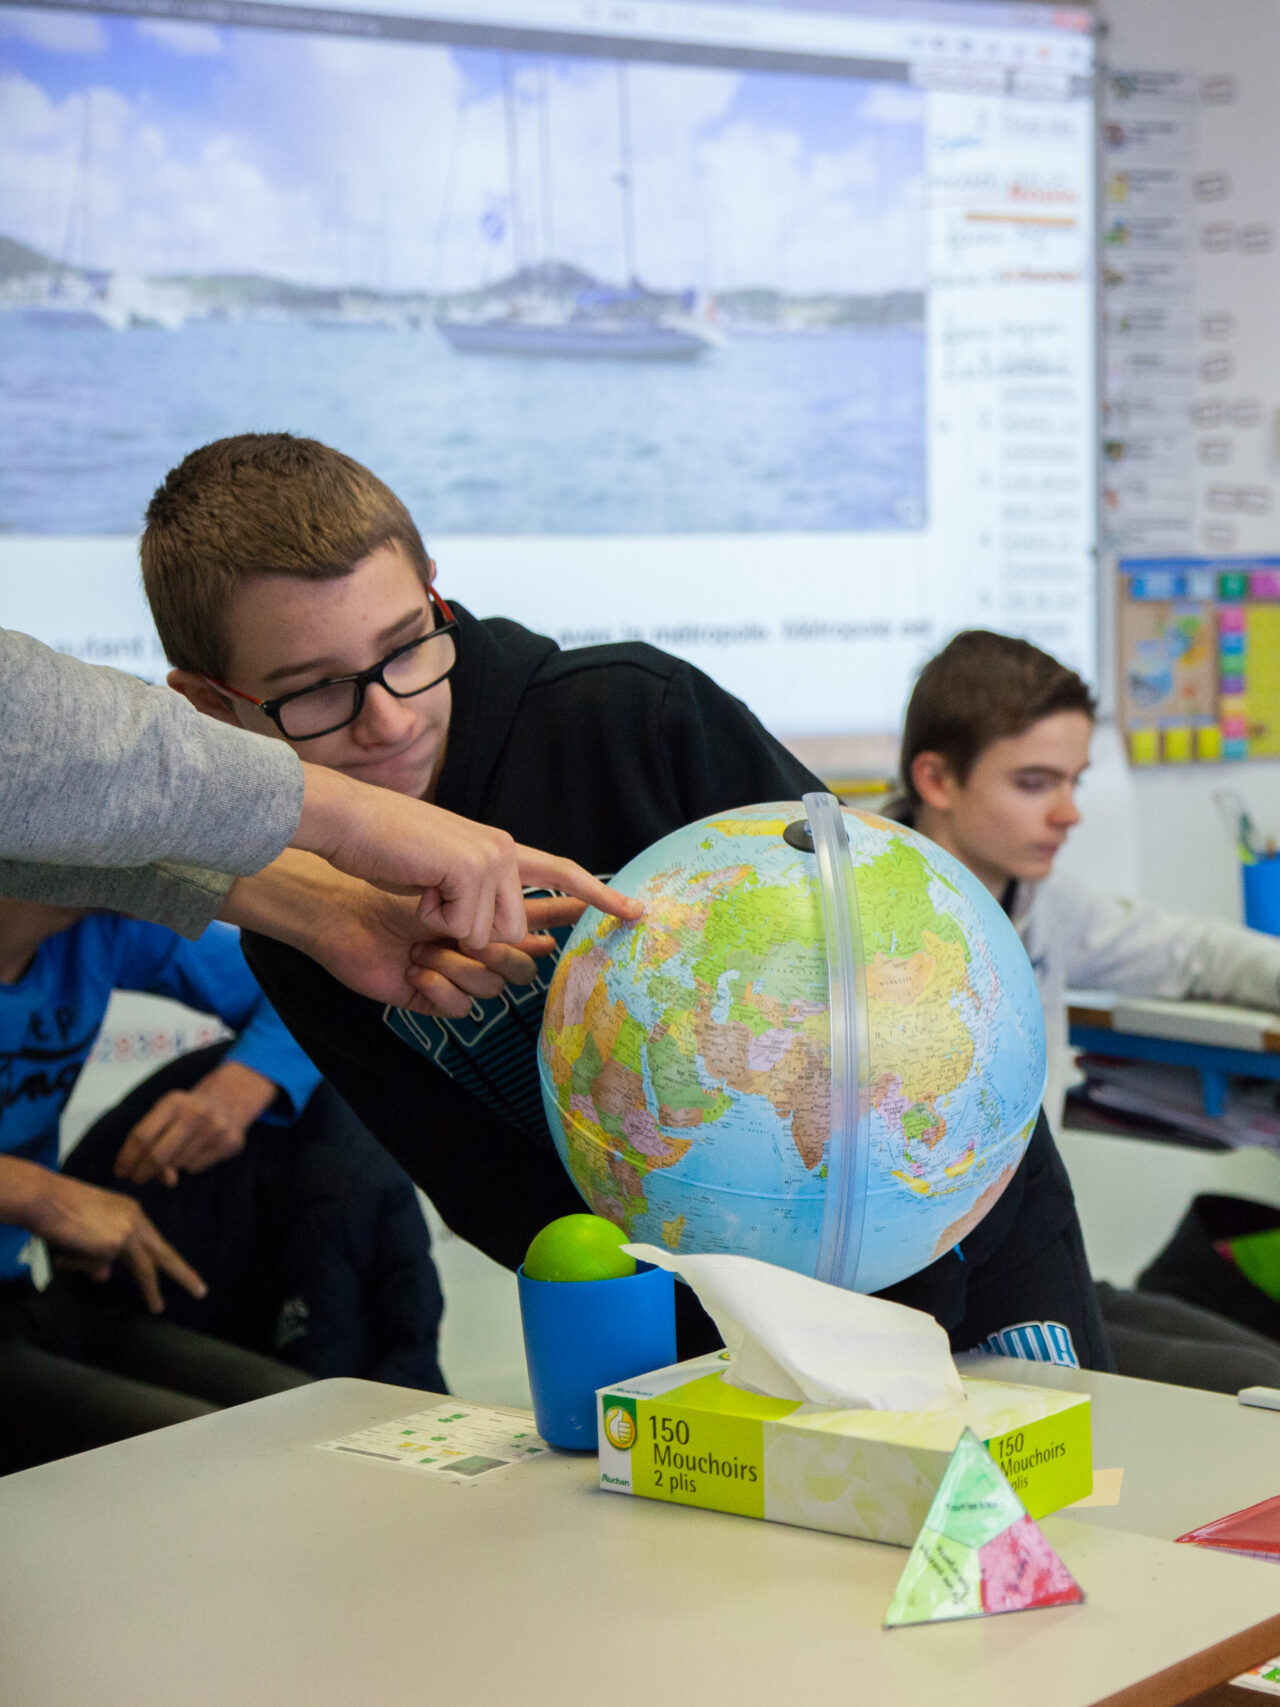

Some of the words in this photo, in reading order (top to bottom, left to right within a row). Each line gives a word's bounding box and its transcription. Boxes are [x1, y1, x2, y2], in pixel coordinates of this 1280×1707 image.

[648, 1415, 690, 1445] 150
[998, 1432, 1025, 1459] 150
[1000, 1442, 1066, 1477] Mouchoirs
[653, 1443, 758, 1482] Mouchoirs
[601, 1473, 630, 1487] Auchan
[654, 1470, 663, 1487] 2
[669, 1473, 697, 1494] plis
